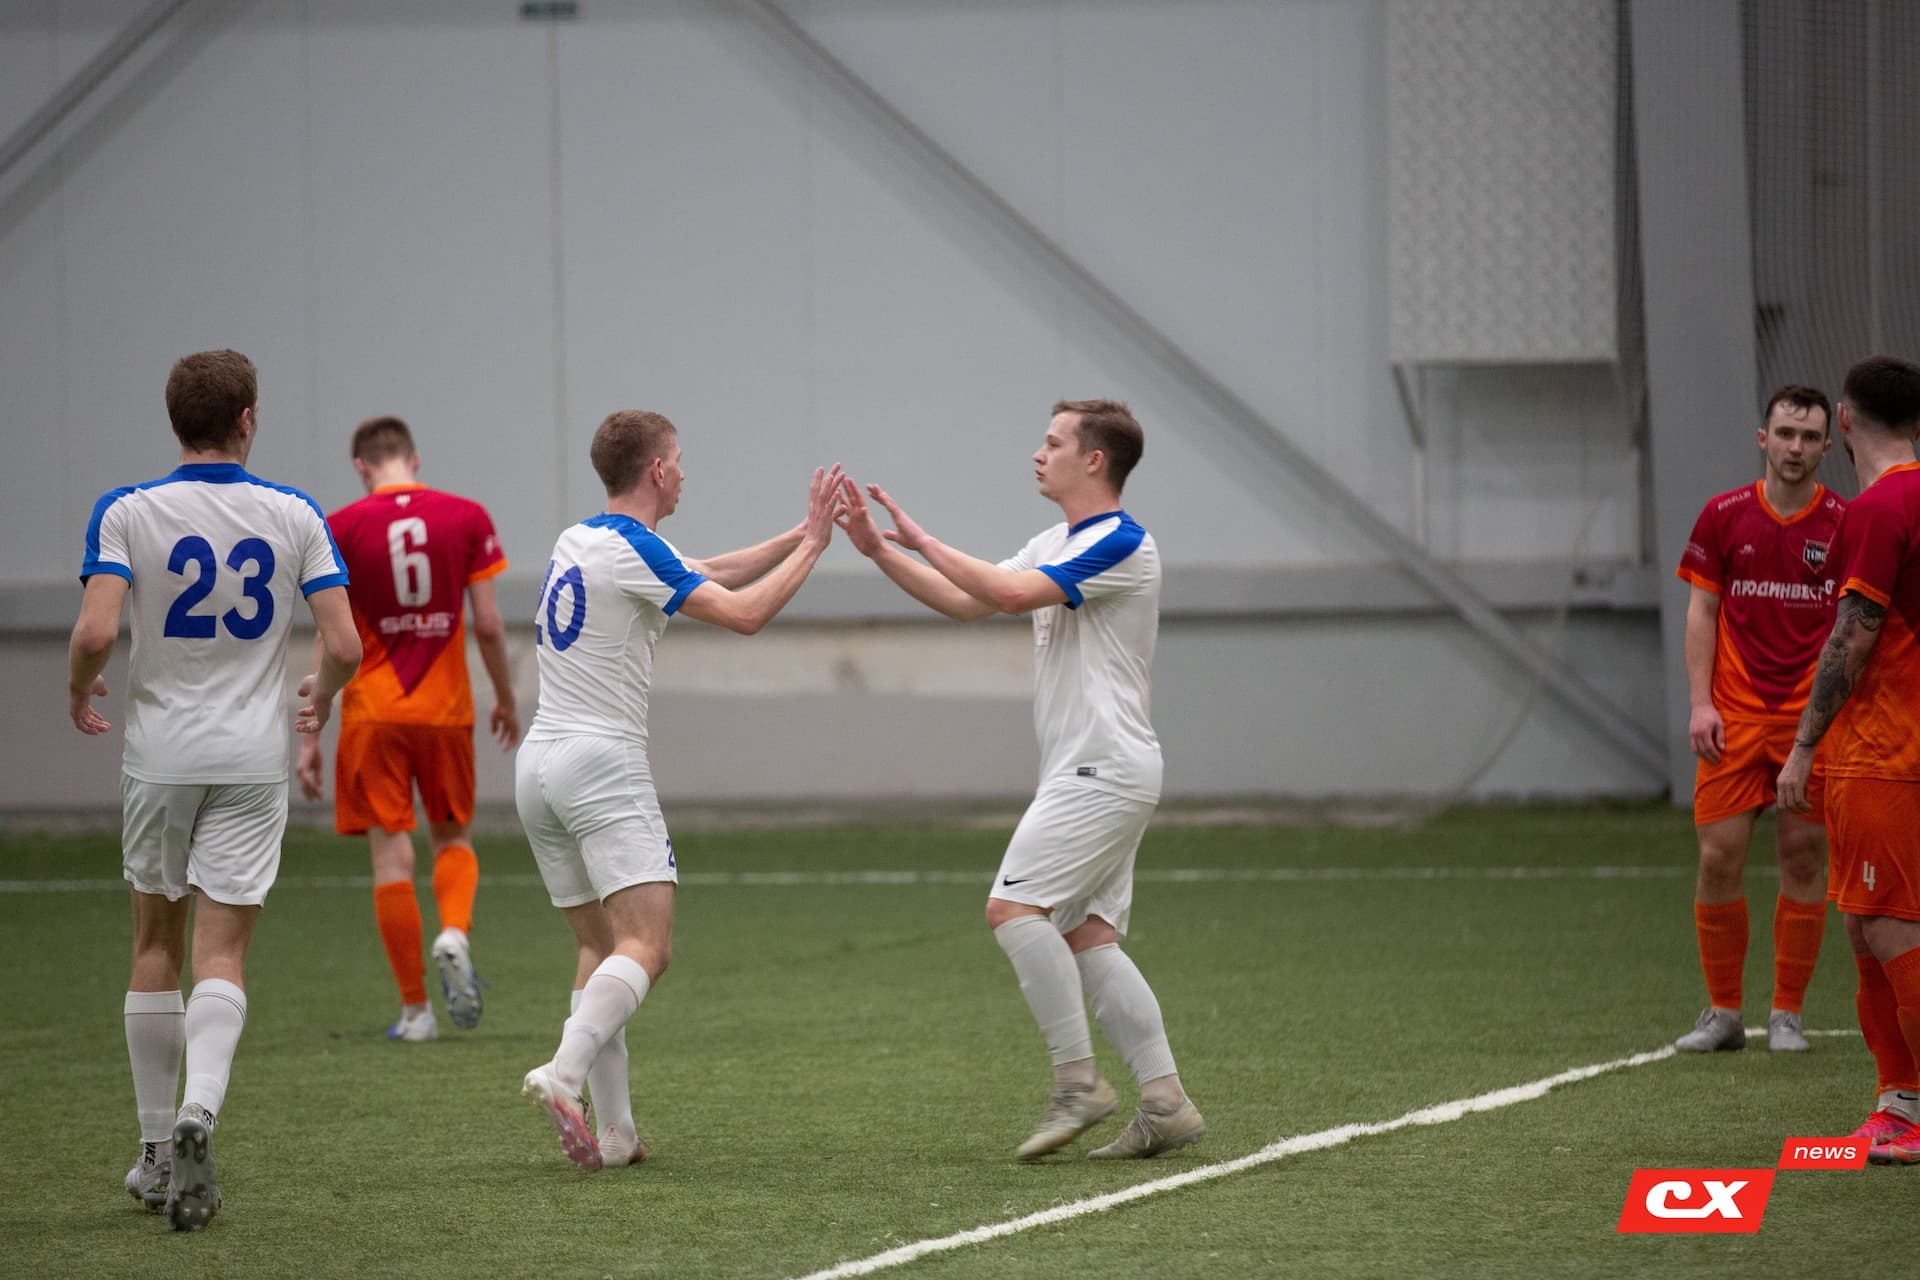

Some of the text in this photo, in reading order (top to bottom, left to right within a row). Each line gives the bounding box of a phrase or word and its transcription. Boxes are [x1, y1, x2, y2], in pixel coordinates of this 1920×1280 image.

[163, 535, 276, 640] 23
[387, 516, 432, 607] 6
[1863, 860, 1876, 892] 4
